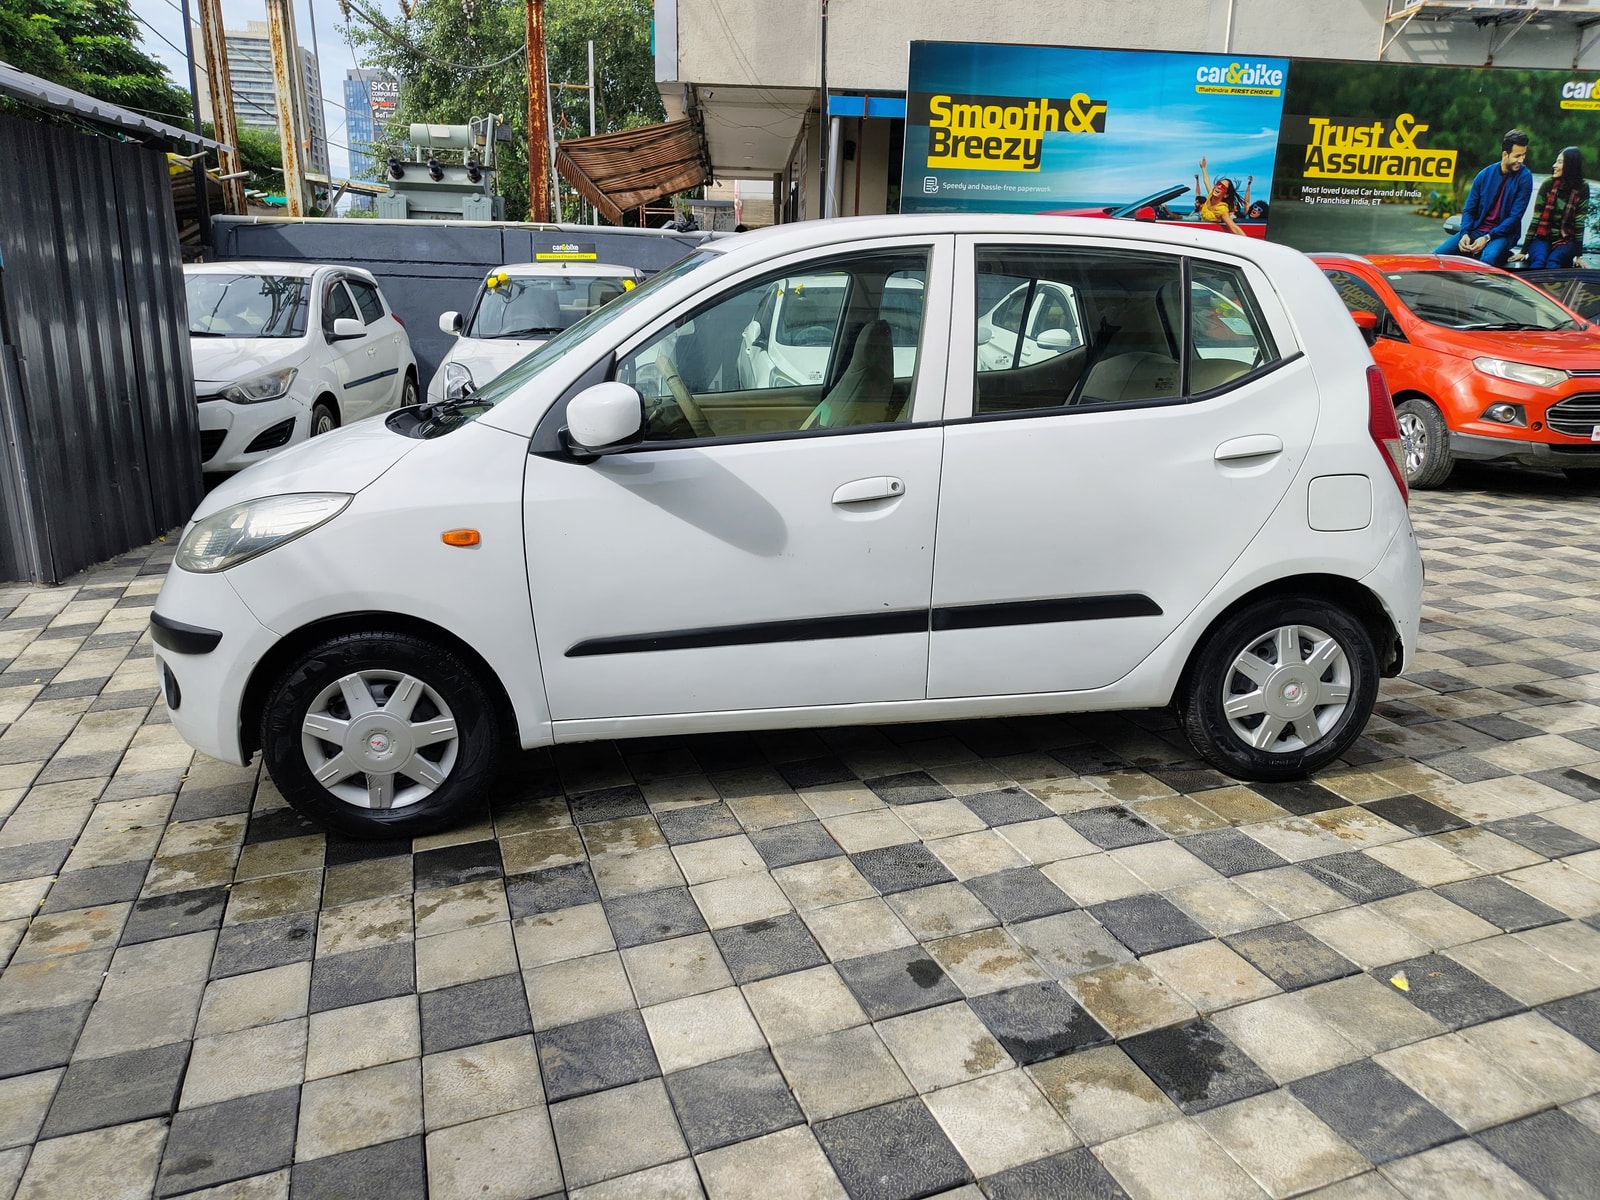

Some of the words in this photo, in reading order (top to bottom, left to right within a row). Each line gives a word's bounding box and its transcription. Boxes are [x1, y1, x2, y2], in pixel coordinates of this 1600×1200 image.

[371, 81, 398, 91] SKYE
[1196, 62, 1283, 86] car&bike
[929, 95, 1059, 132] Smooth
[1064, 92, 1107, 133] &
[1308, 117, 1385, 148] Trust
[1389, 113, 1429, 150] &
[927, 127, 1043, 169] Breezy
[1304, 145, 1452, 178] Assurance
[942, 181, 967, 191] Speedy
[981, 183, 1016, 191] hassle-free
[1017, 185, 1051, 193] paperwork
[1301, 186, 1320, 194] Most
[1321, 186, 1340, 195] loved
[1341, 187, 1359, 196] Used
[1360, 188, 1372, 196] Car
[1373, 188, 1394, 197] brand
[1395, 189, 1404, 197] of
[1404, 190, 1422, 198] India
[1305, 195, 1315, 205] By
[1316, 196, 1350, 205] Franchise
[1351, 197, 1371, 206] India,
[1371, 198, 1381, 206] ET
